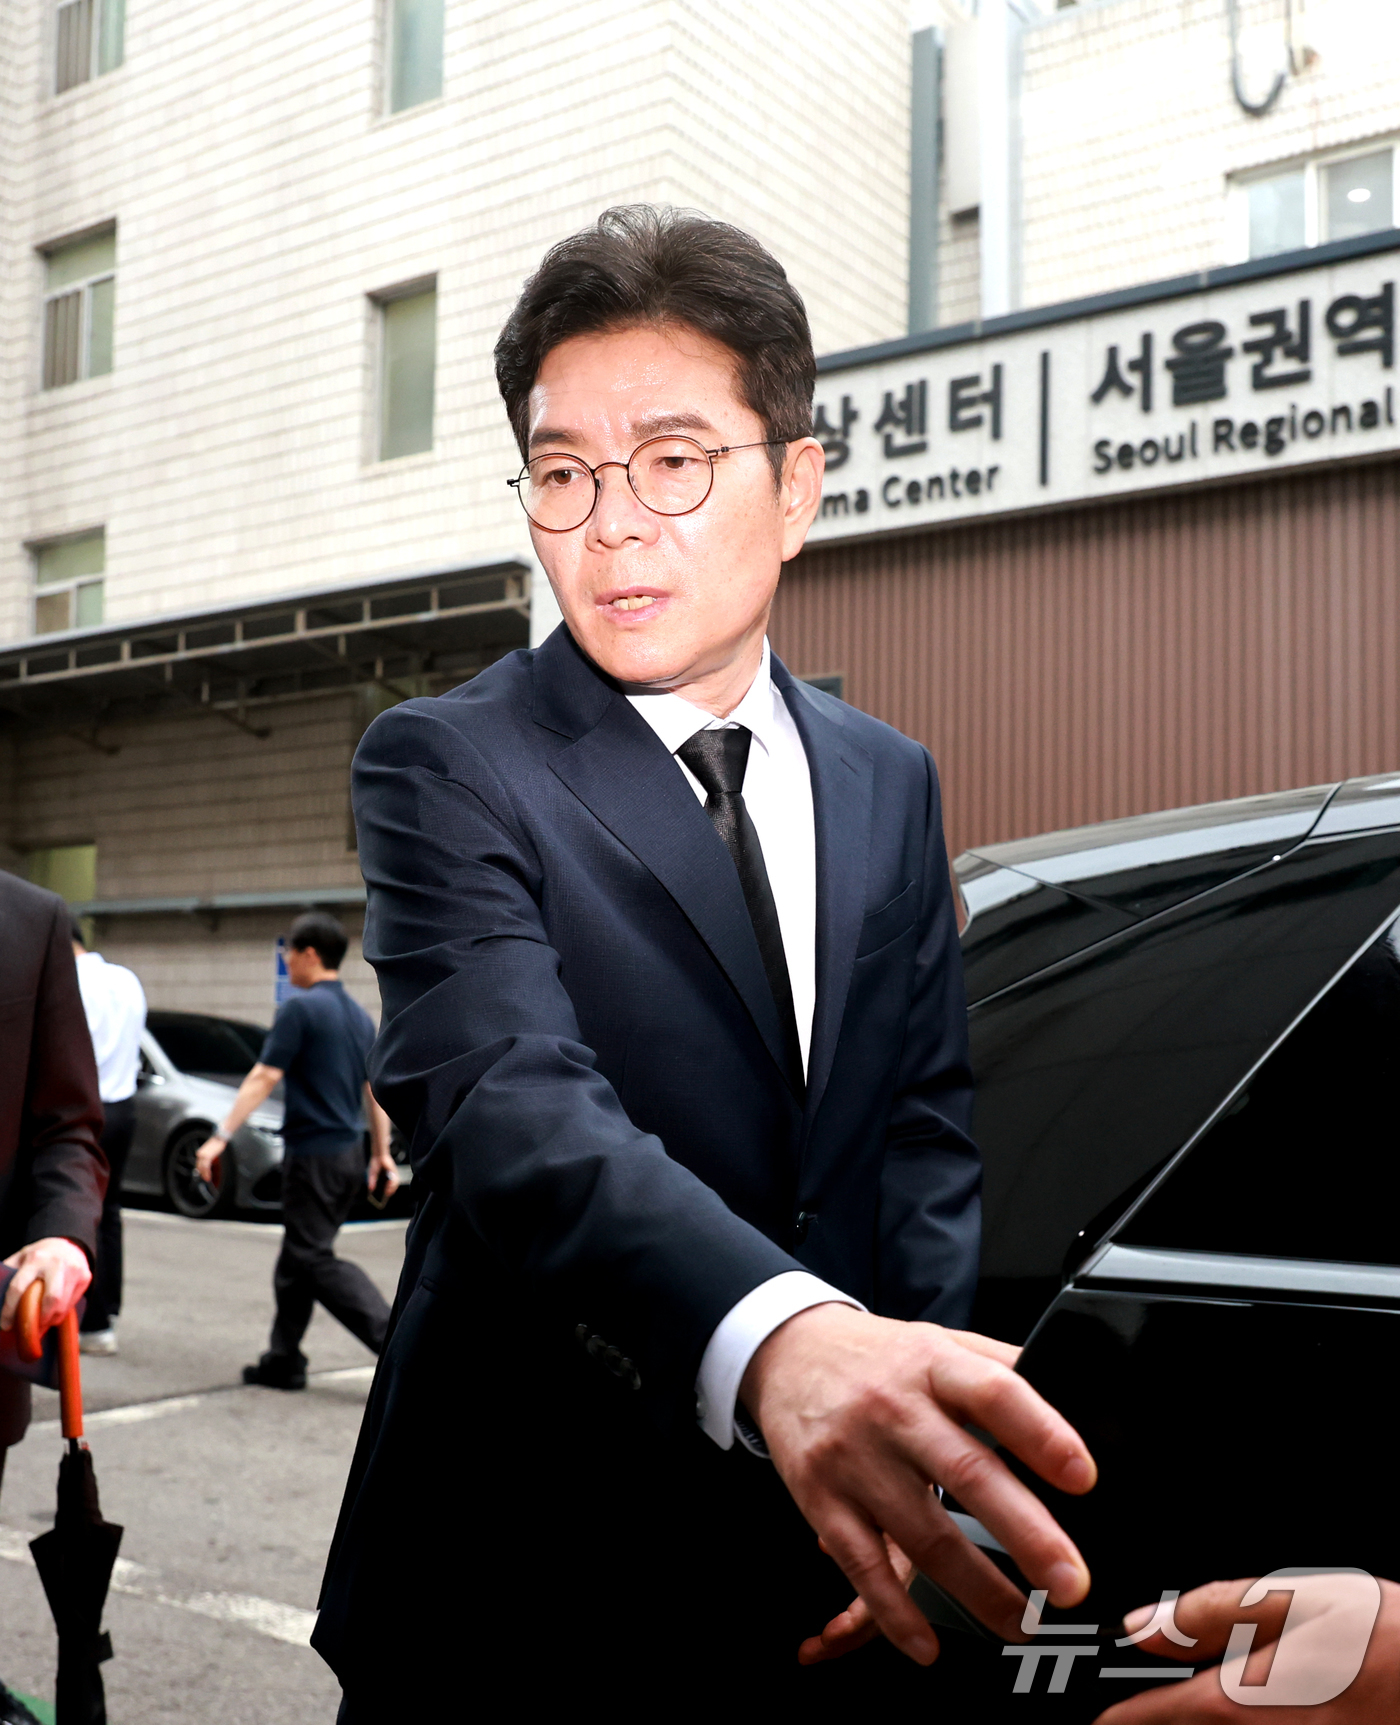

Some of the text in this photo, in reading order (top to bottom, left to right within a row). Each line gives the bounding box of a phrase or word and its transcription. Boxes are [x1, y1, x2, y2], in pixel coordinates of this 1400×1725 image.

[1091, 281, 1394, 413] 서울권역
[1094, 386, 1393, 475] Seoul Regional
[813, 464, 999, 519] ma Center
